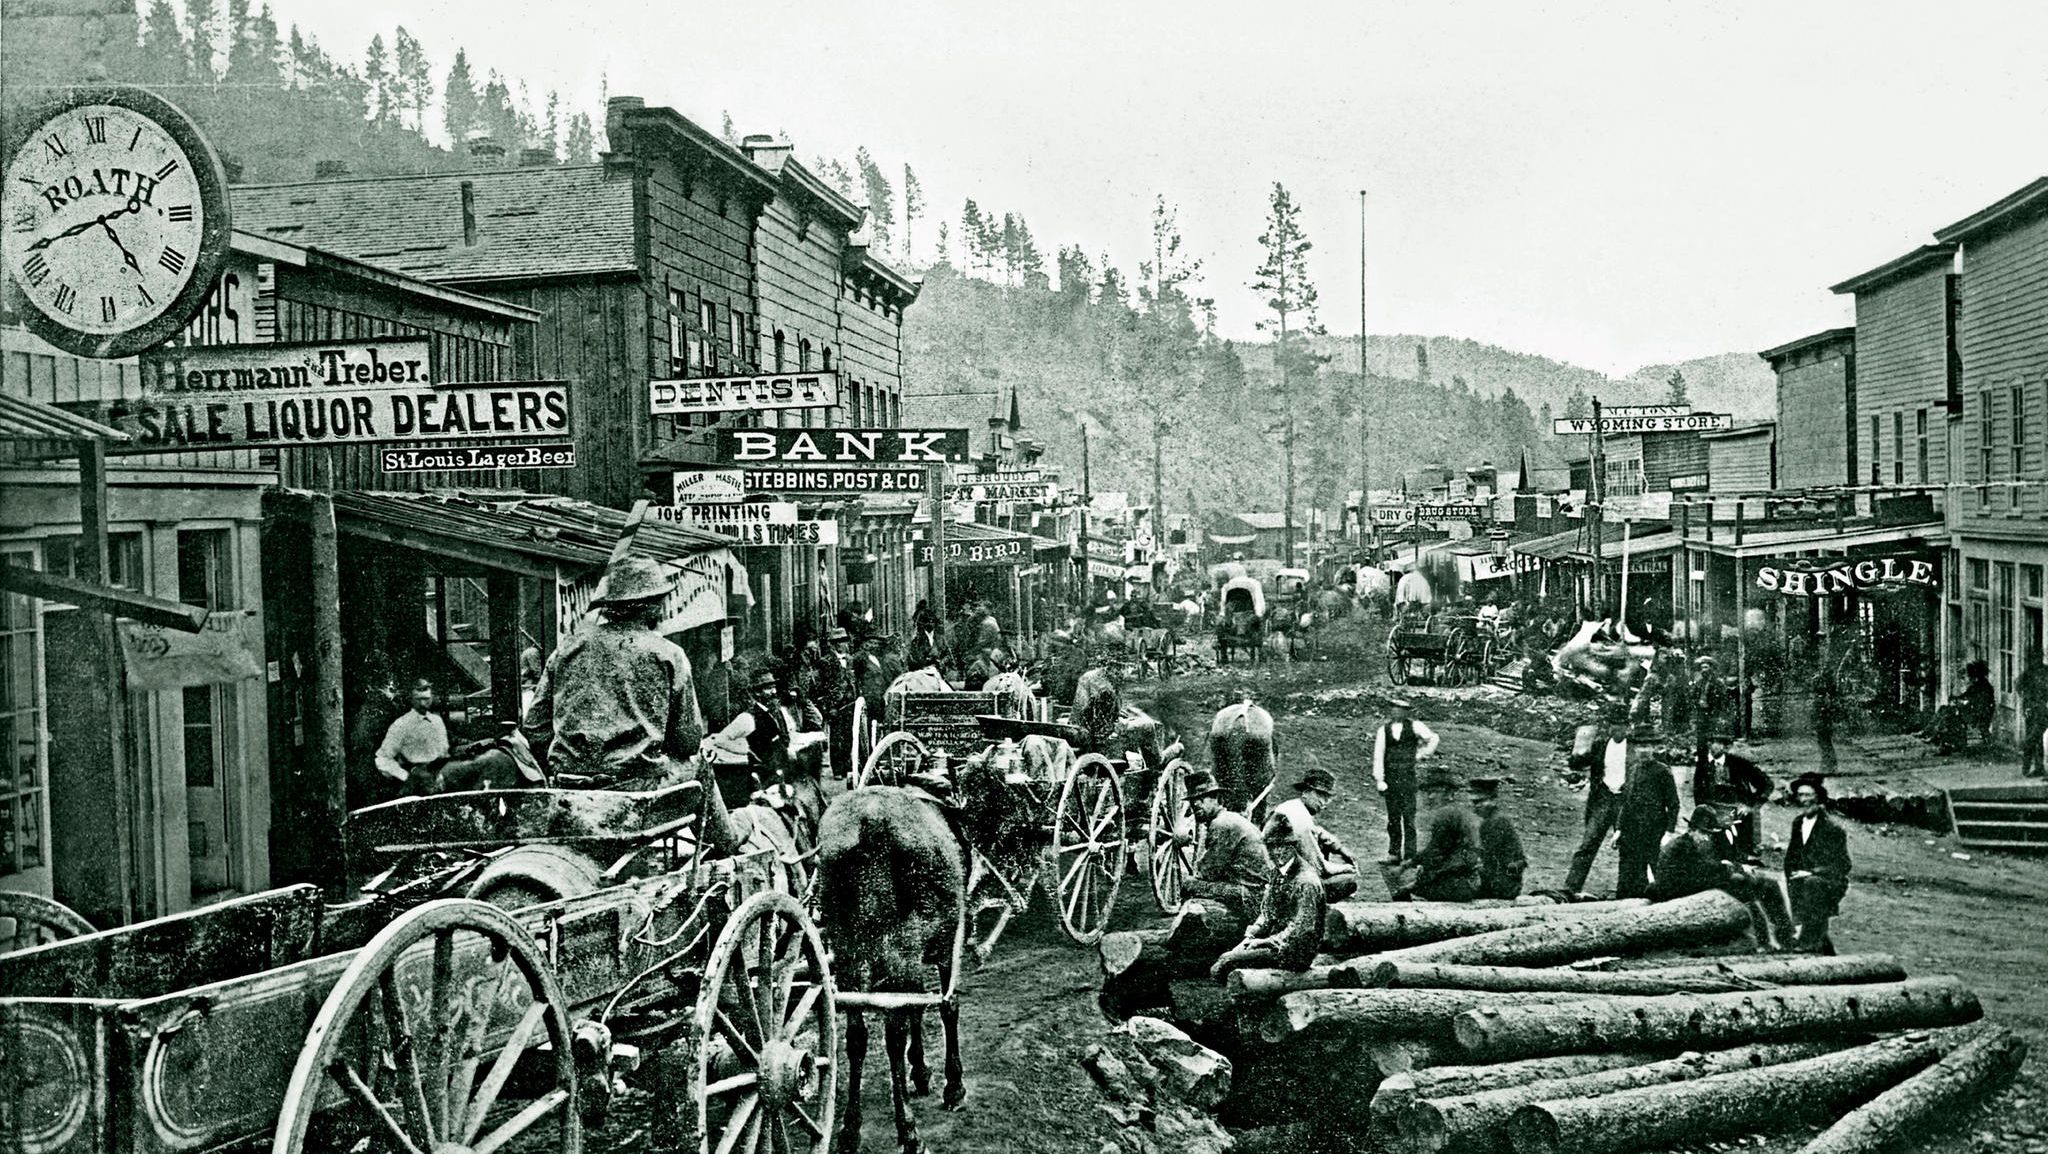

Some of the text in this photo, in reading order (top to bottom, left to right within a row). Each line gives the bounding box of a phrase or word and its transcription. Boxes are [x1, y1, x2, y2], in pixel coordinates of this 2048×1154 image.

[157, 360, 312, 392] Herrmann
[319, 348, 429, 386] Treber.
[244, 396, 377, 441] LIQUOR
[391, 390, 568, 436] DEALERS
[1570, 416, 1725, 431] WYOMING STORE.
[733, 432, 961, 461] BANK.
[407, 451, 465, 468] Louis
[467, 449, 525, 469] Lager
[525, 448, 575, 466] Beer
[676, 473, 704, 493] MILLER
[881, 472, 894, 489] &
[984, 485, 1049, 499] MARKET
[691, 504, 771, 522] PRINTING
[1379, 509, 1401, 520] DRY
[1419, 506, 1444, 516] DRUG
[766, 523, 820, 544] TIMES
[969, 541, 1026, 561] BIRD.
[1756, 558, 1937, 596] SHINGLE.
